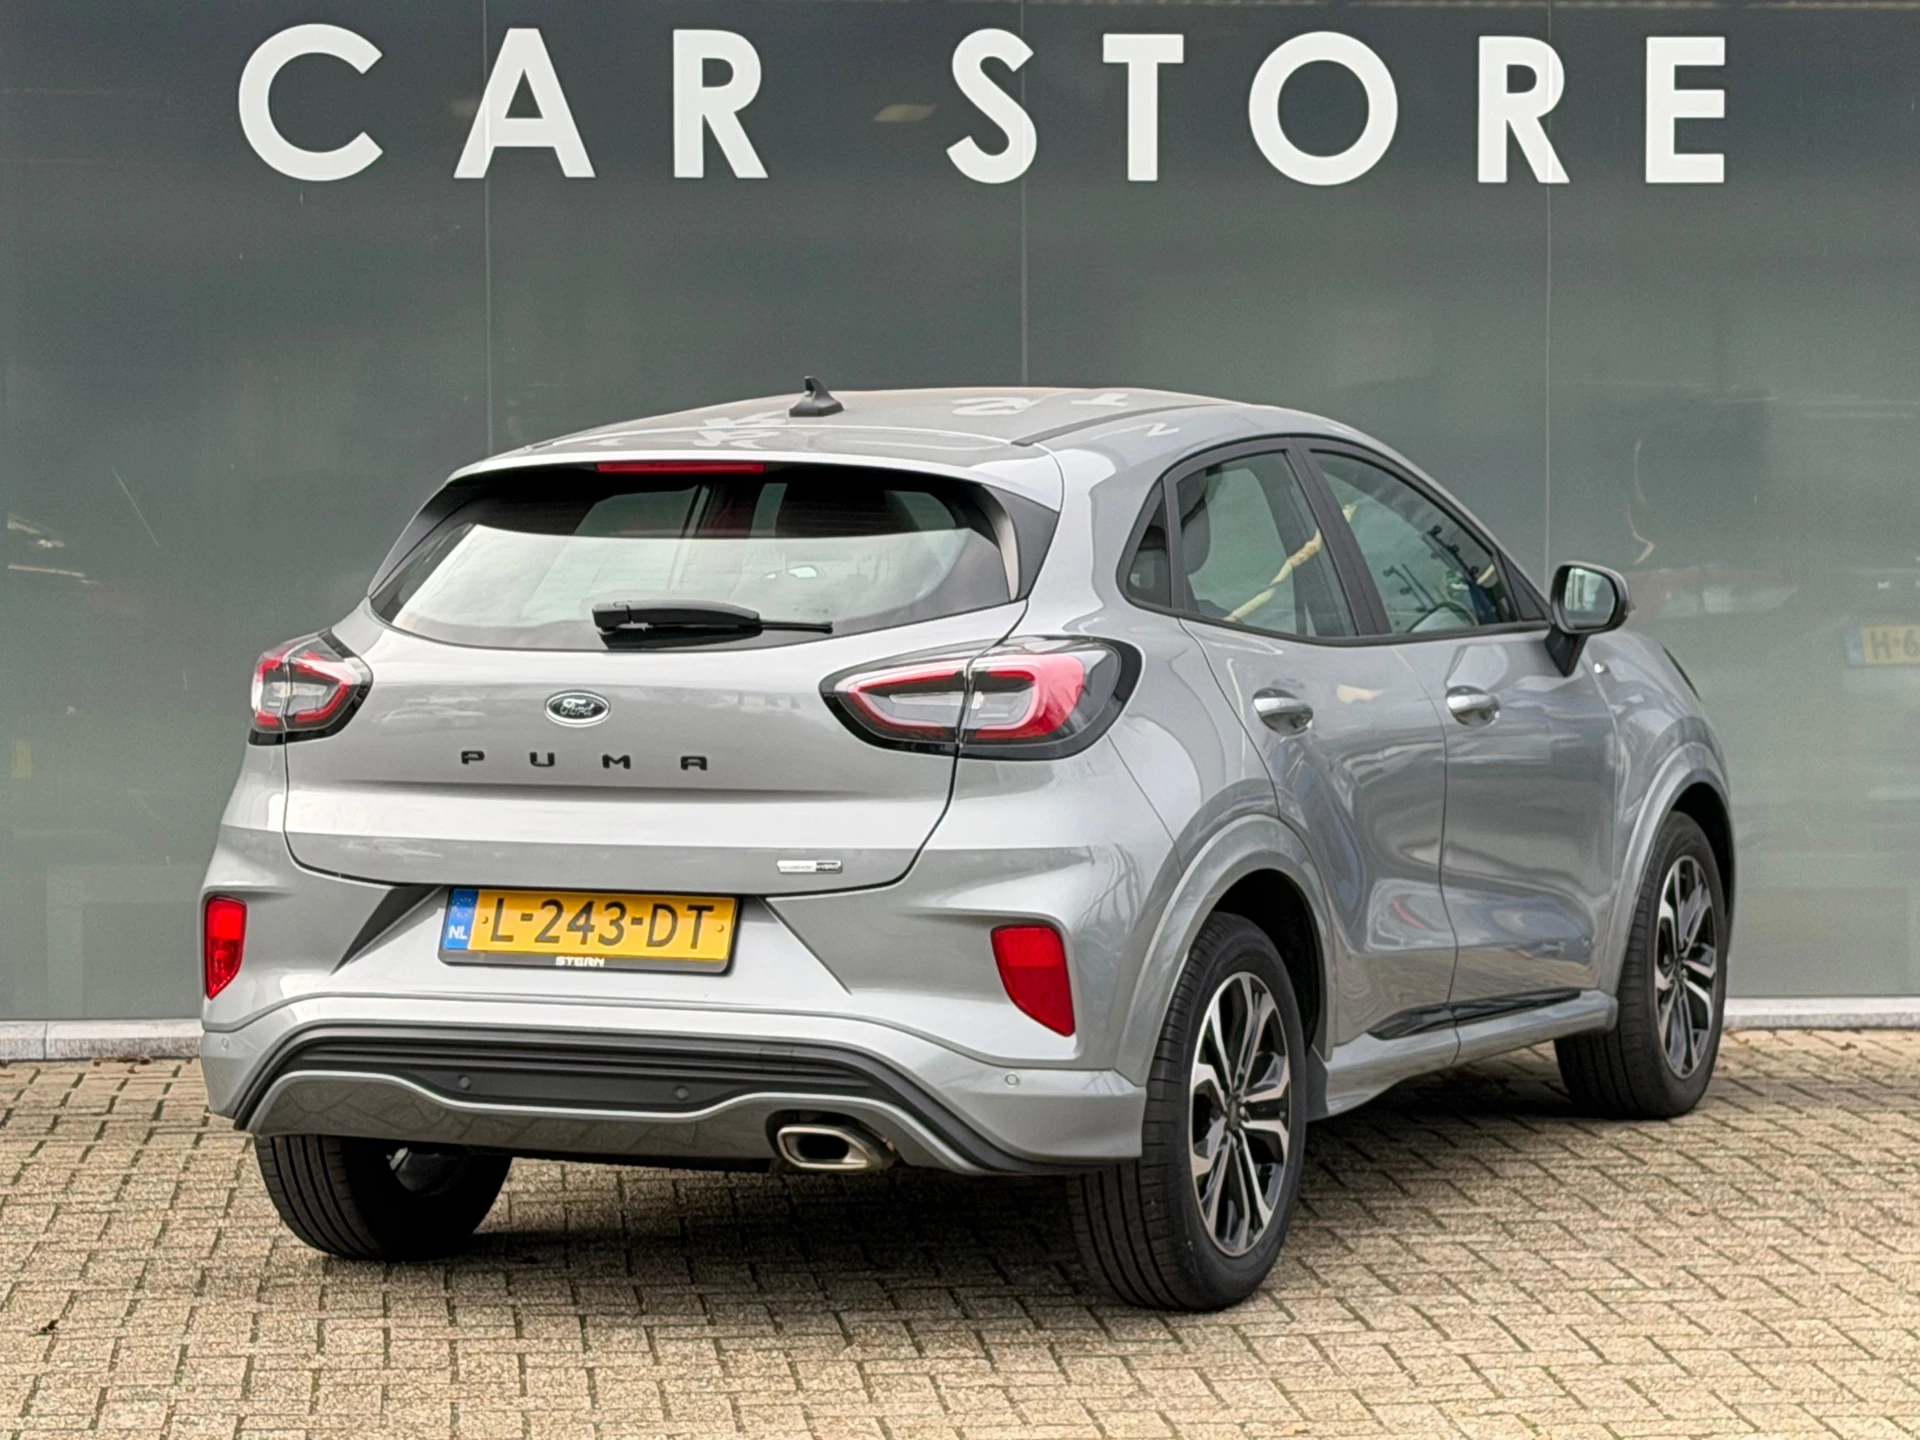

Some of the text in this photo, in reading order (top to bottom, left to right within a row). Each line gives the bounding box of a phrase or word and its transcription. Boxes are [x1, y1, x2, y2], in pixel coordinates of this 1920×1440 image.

[239, 24, 1726, 186] CAR STORE
[560, 698, 596, 715] Ford
[461, 751, 708, 771] PUMA
[490, 897, 715, 949] L-243-DT
[449, 926, 468, 940] NL
[555, 956, 605, 967] STERN
